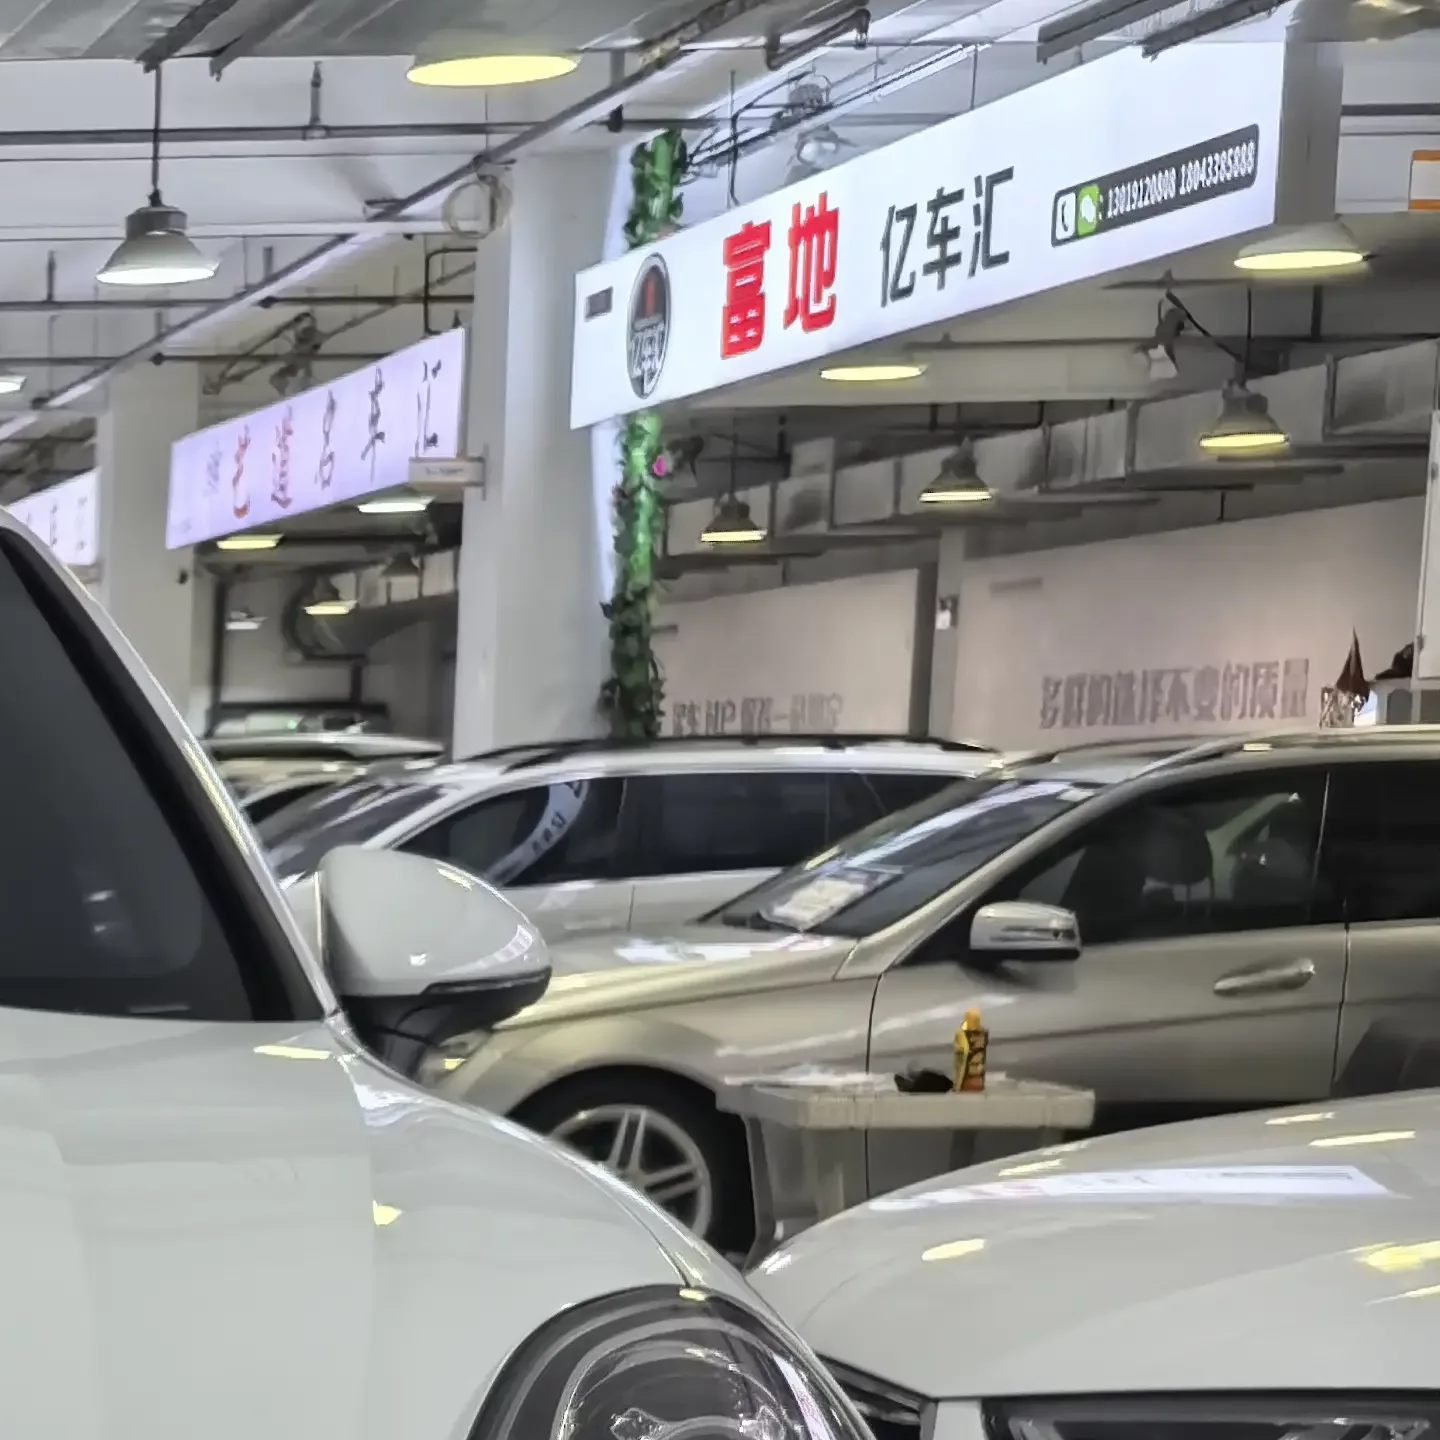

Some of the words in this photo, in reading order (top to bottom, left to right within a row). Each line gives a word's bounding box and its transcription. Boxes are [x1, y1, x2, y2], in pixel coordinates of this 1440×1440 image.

[721, 192, 841, 360] 富地
[879, 165, 1015, 309] 亿车汇
